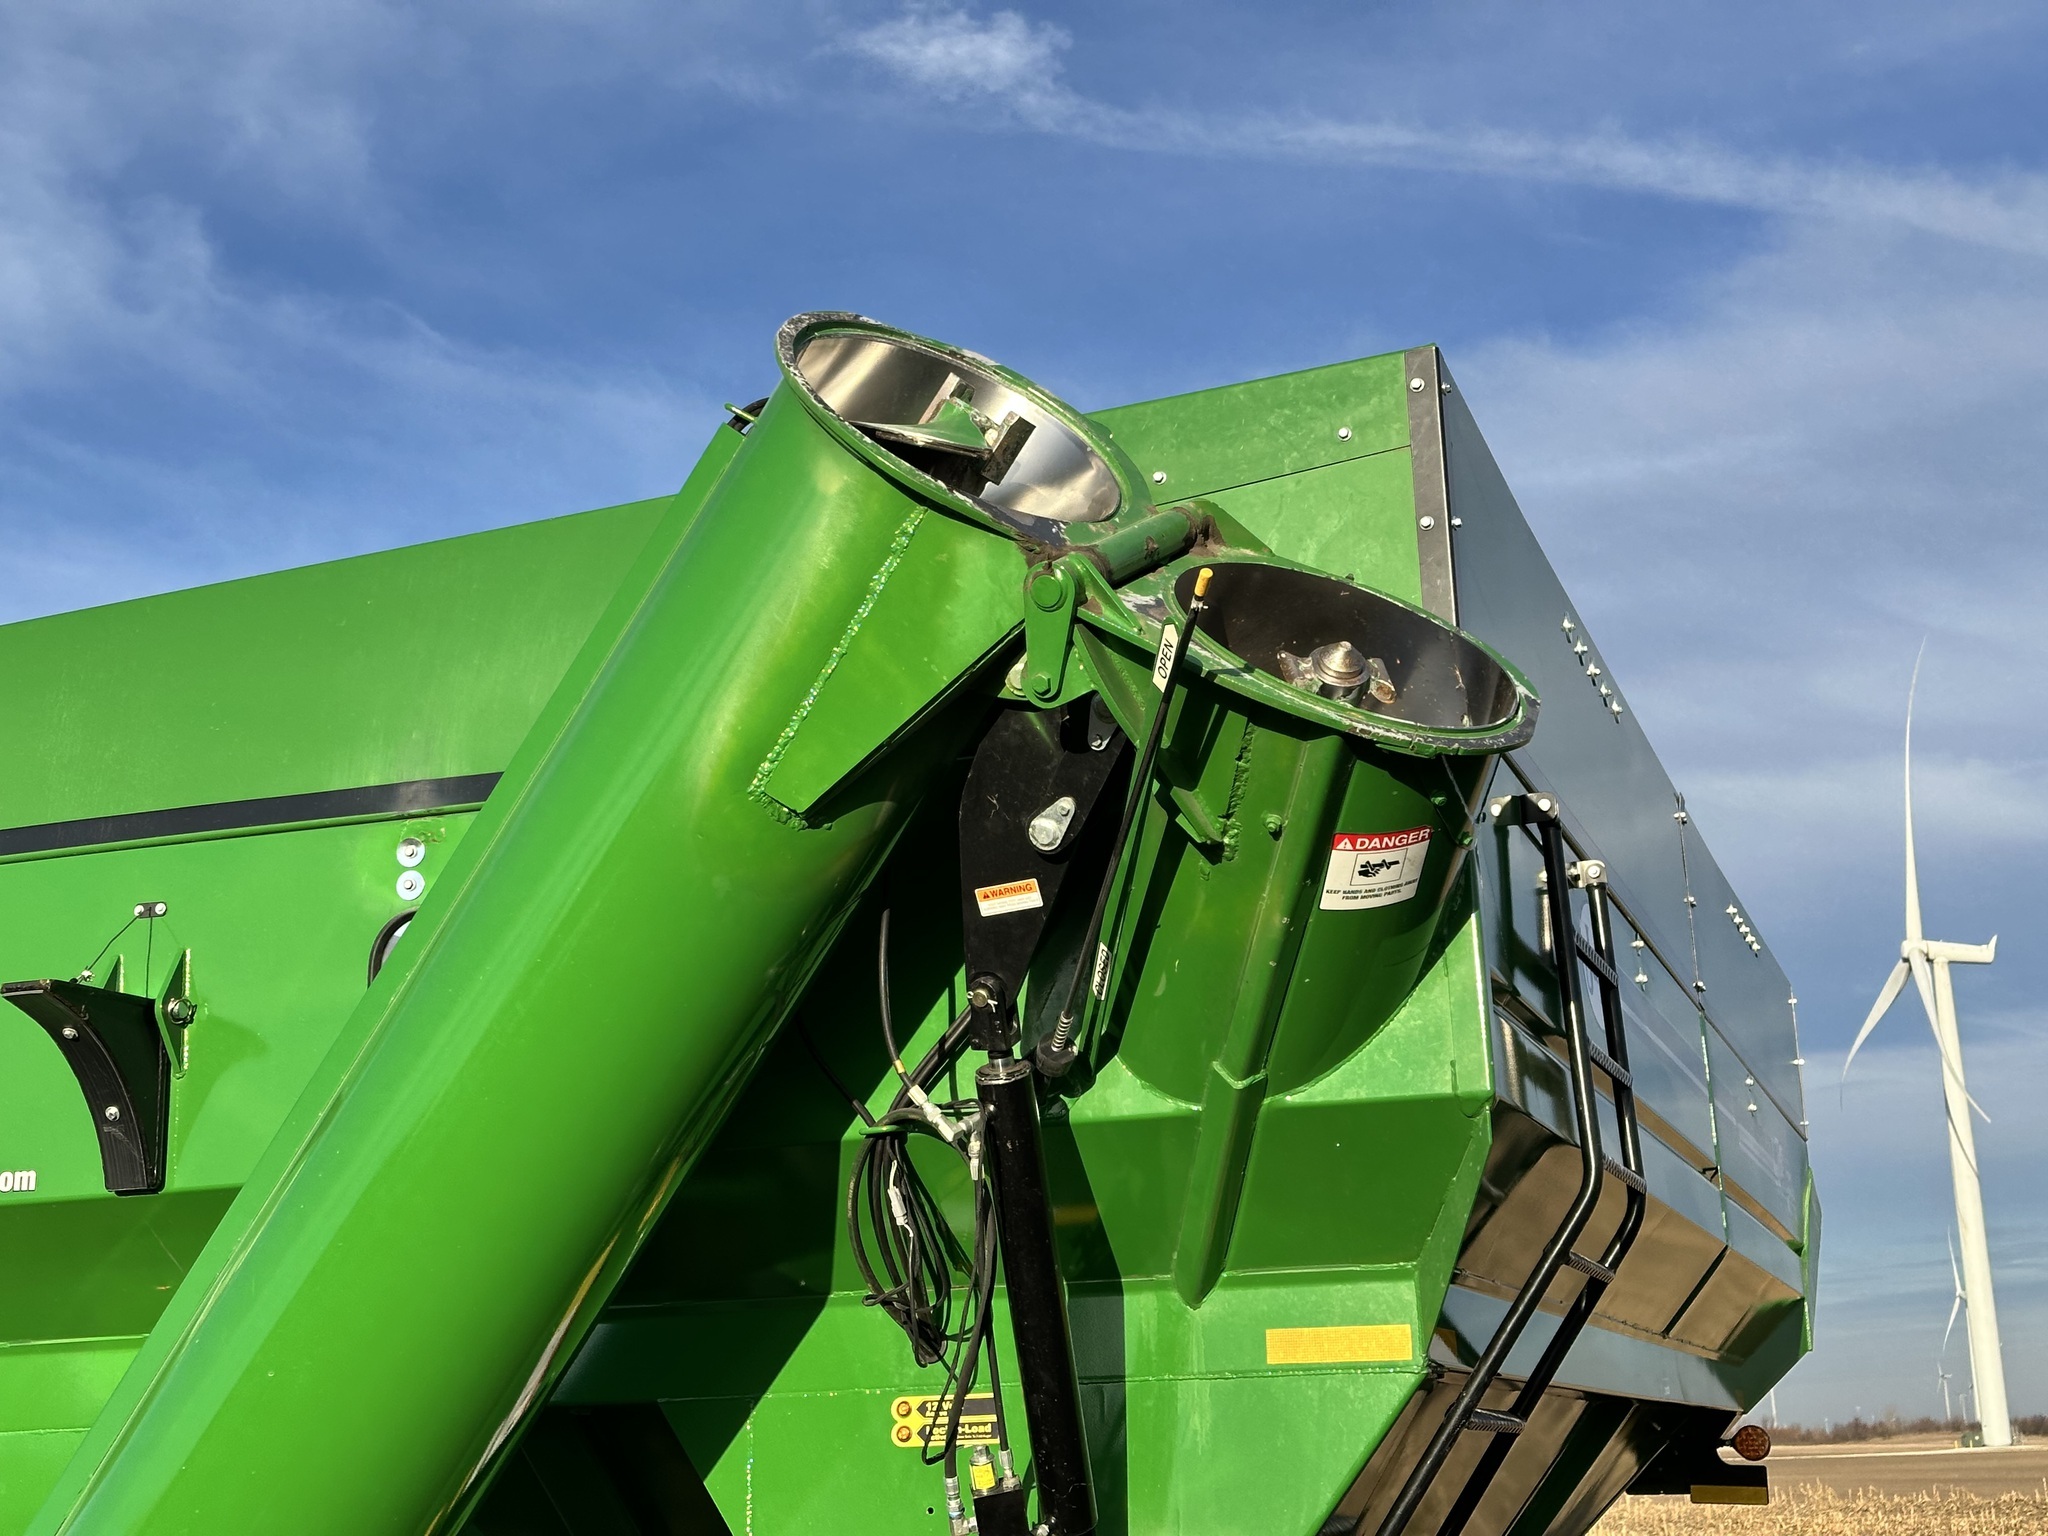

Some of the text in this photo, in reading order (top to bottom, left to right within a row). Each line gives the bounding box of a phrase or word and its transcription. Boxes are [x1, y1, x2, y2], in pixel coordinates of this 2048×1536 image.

[1157, 638, 1175, 680] OPEN
[1355, 828, 1431, 850] DANGER
[989, 883, 1033, 898] WARNING
[1377, 883, 1404, 892] CLOTHING
[1095, 949, 1109, 996] CLOSED
